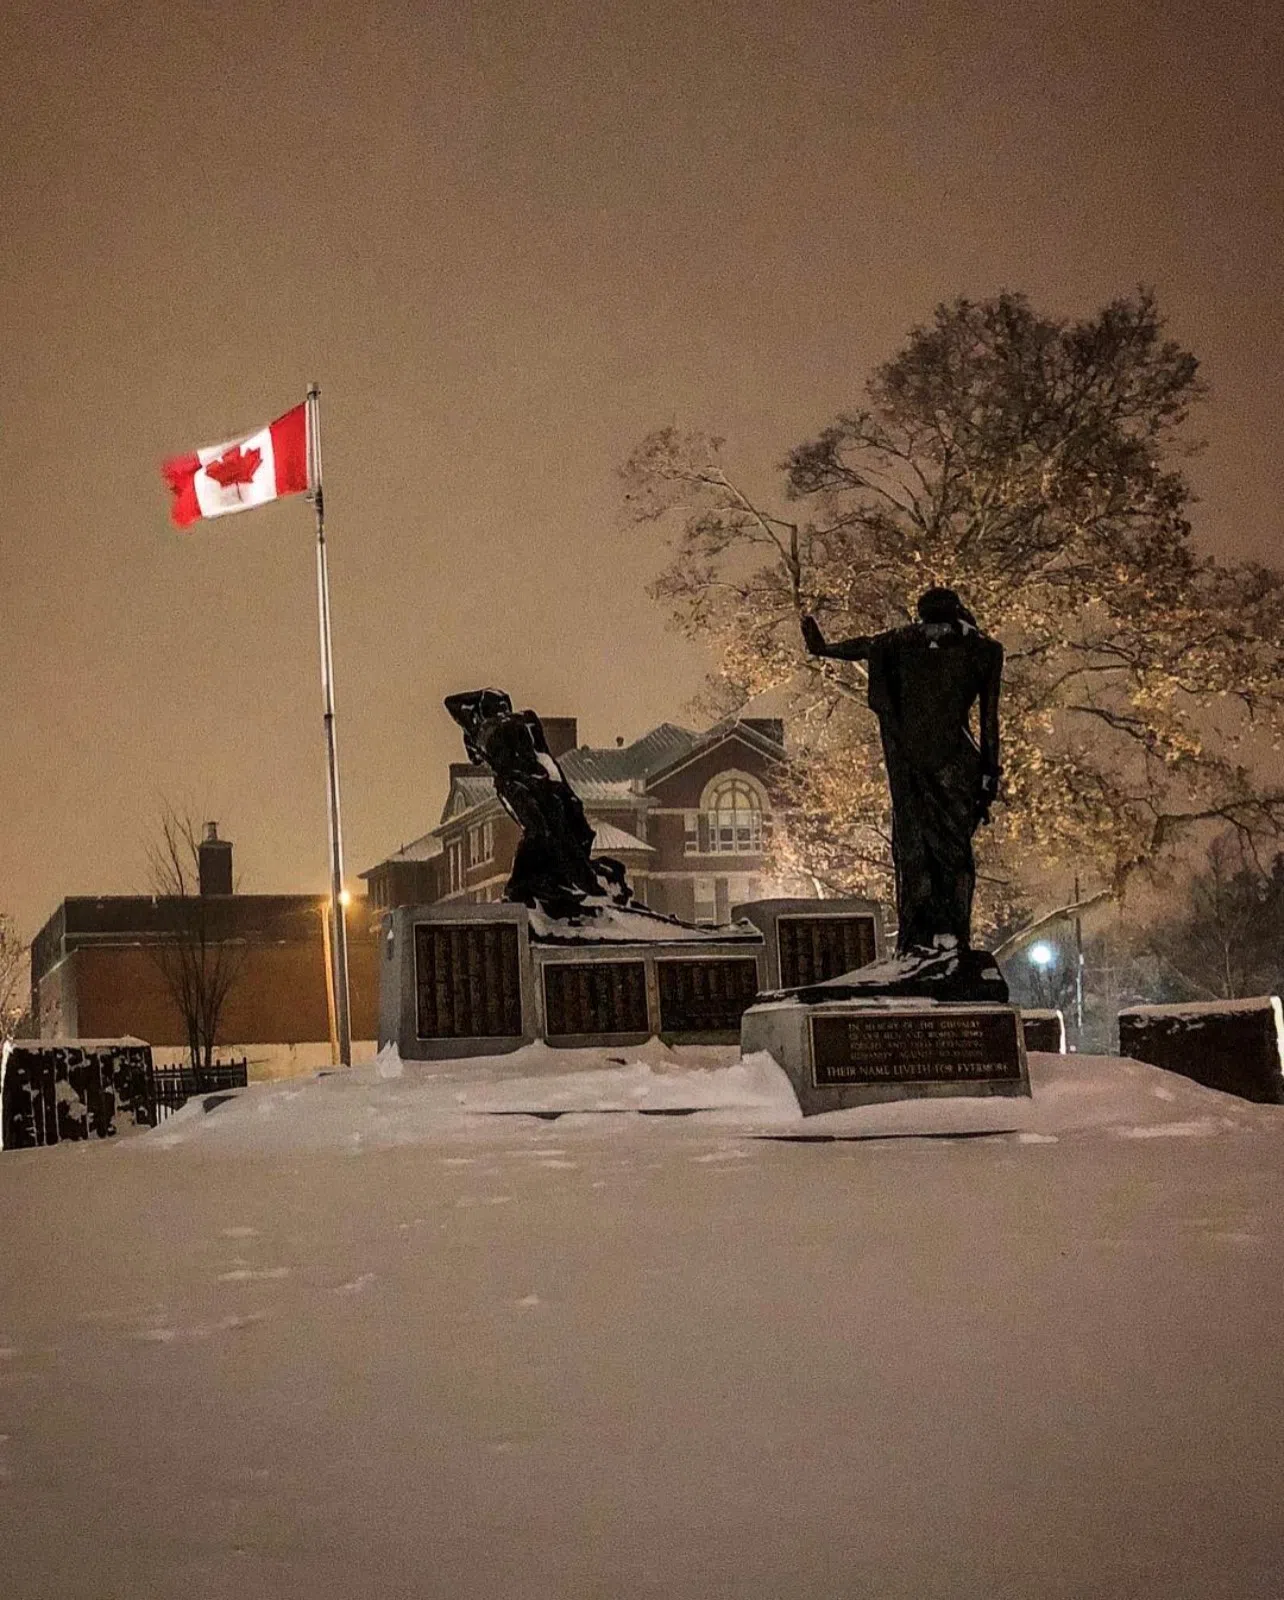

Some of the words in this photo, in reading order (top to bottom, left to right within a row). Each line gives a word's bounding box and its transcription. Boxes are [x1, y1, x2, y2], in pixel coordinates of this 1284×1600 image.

[826, 1066, 857, 1077] THEIR
[859, 1065, 890, 1076] NAME
[893, 1063, 931, 1076] LIVETH
[934, 1063, 954, 1074] FOR
